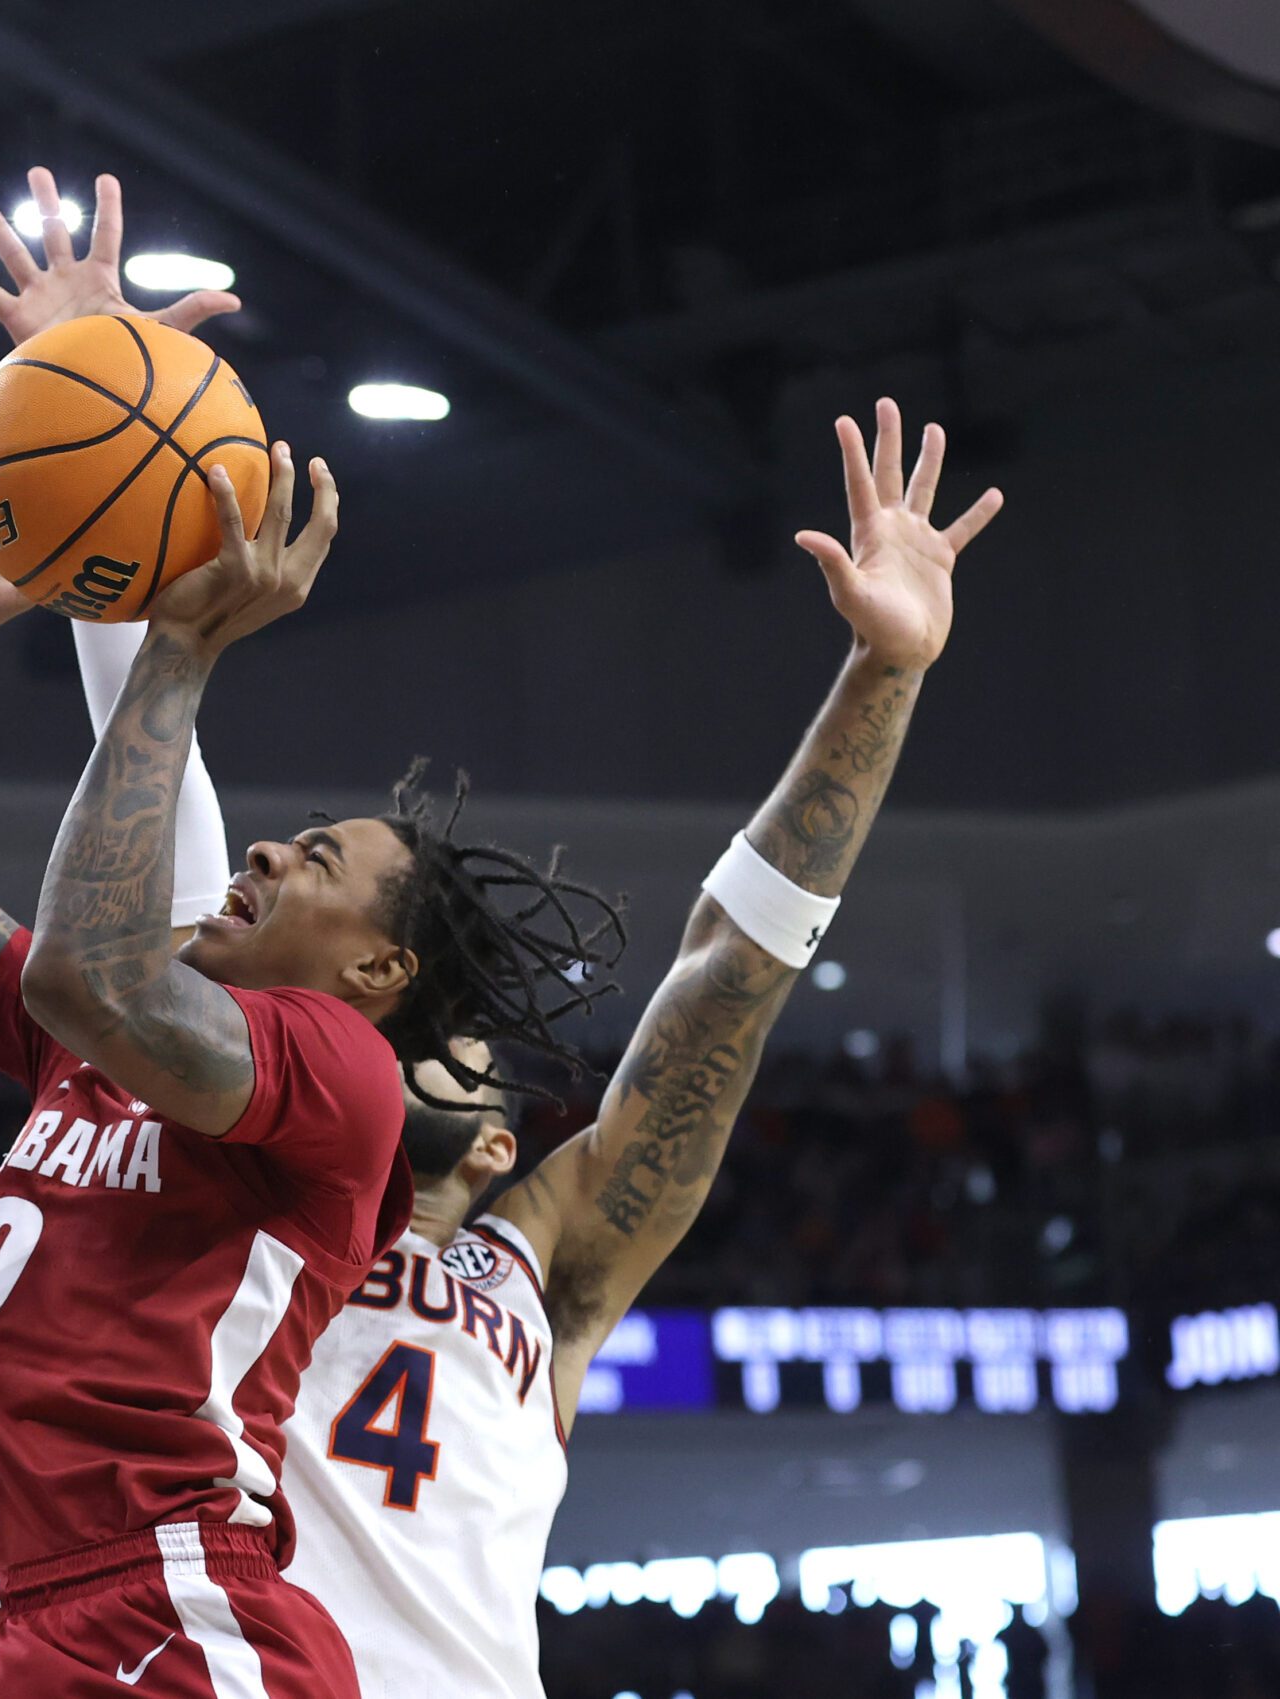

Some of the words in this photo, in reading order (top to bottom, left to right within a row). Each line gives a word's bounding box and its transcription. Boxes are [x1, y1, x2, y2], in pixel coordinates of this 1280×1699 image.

[38, 554, 142, 620] Wil
[4, 1109, 163, 1194] BAMA
[440, 1242, 496, 1279] SEC
[342, 1247, 542, 1408] BURN
[327, 1339, 440, 1512] 4
